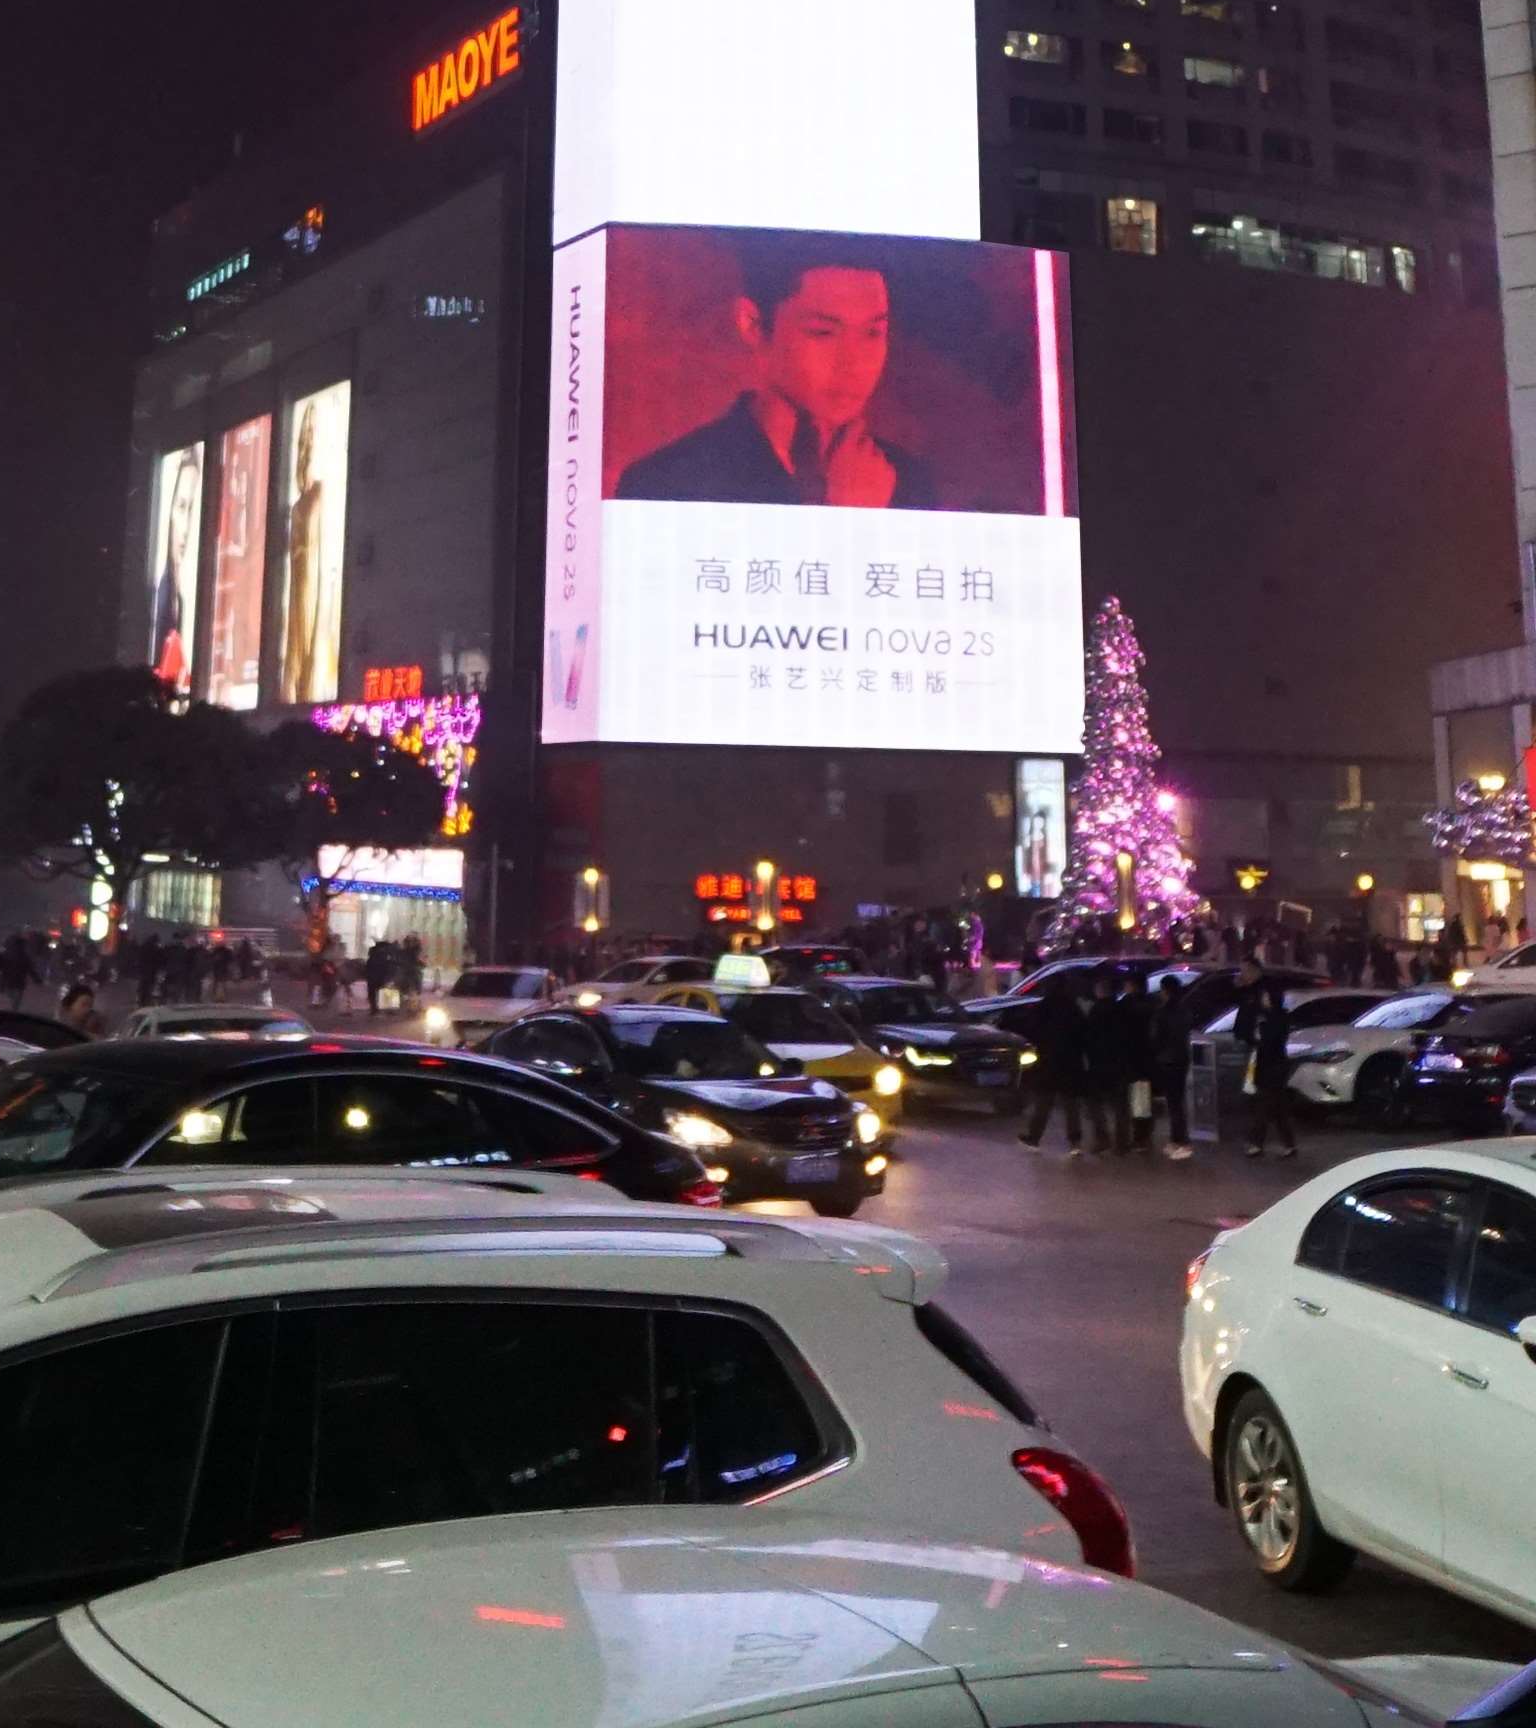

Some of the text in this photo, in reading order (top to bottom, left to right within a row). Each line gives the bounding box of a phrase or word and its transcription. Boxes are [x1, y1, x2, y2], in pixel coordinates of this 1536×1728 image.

[411, 7, 521, 130] MAOYE
[567, 284, 581, 443] HUAWEI
[565, 458, 579, 553] nova
[694, 557, 996, 603] 高颜值 爱自拍
[693, 624, 995, 657] HUAWEI nova 2S
[749, 665, 948, 696] 张艺兴定制版
